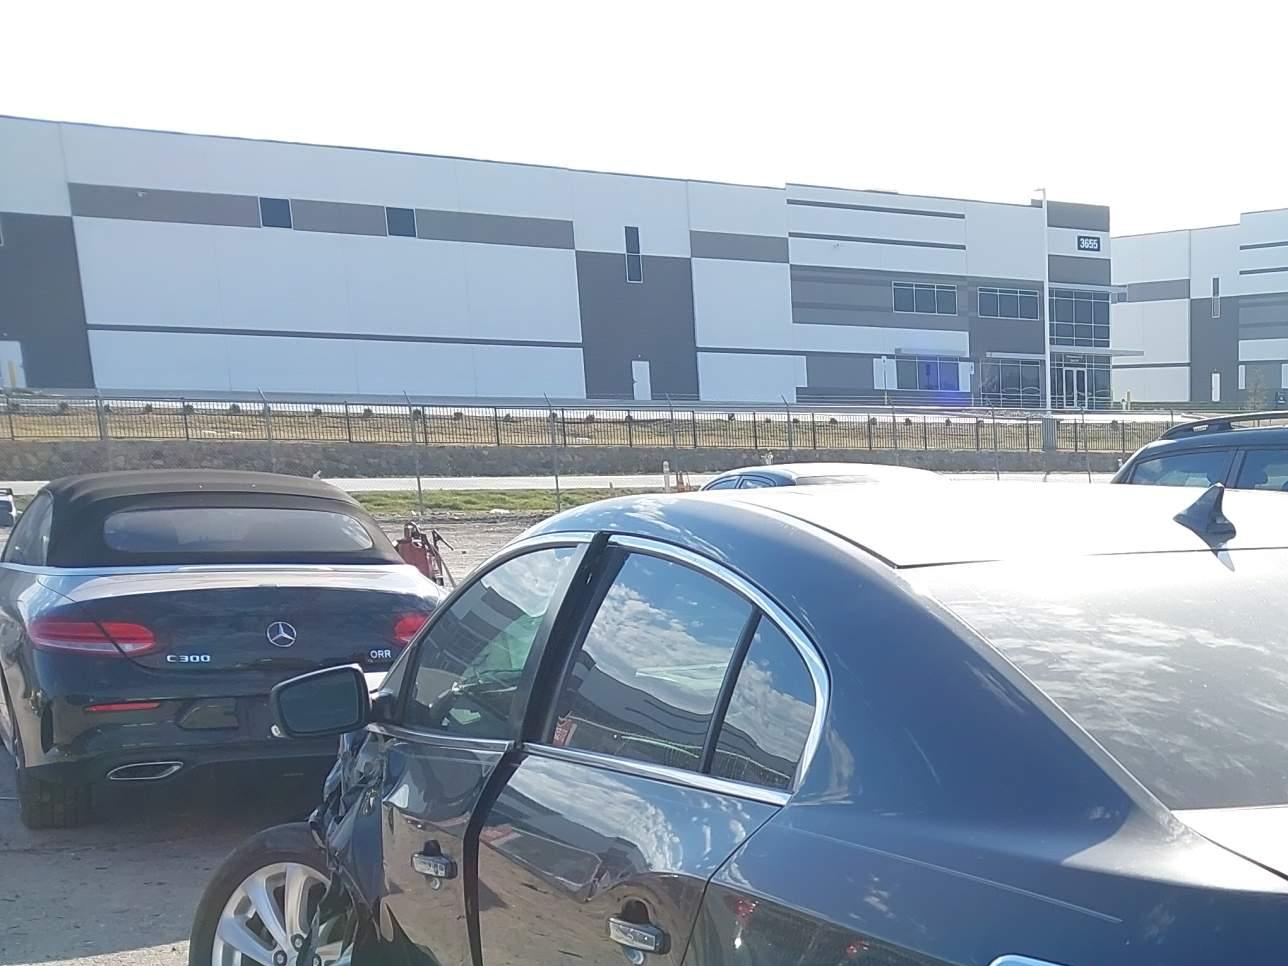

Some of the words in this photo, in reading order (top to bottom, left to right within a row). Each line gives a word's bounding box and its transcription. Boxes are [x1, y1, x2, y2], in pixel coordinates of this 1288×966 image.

[1079, 237, 1099, 249] 3655
[166, 654, 177, 663] C
[178, 654, 211, 663] 300
[370, 649, 392, 659] ORR
